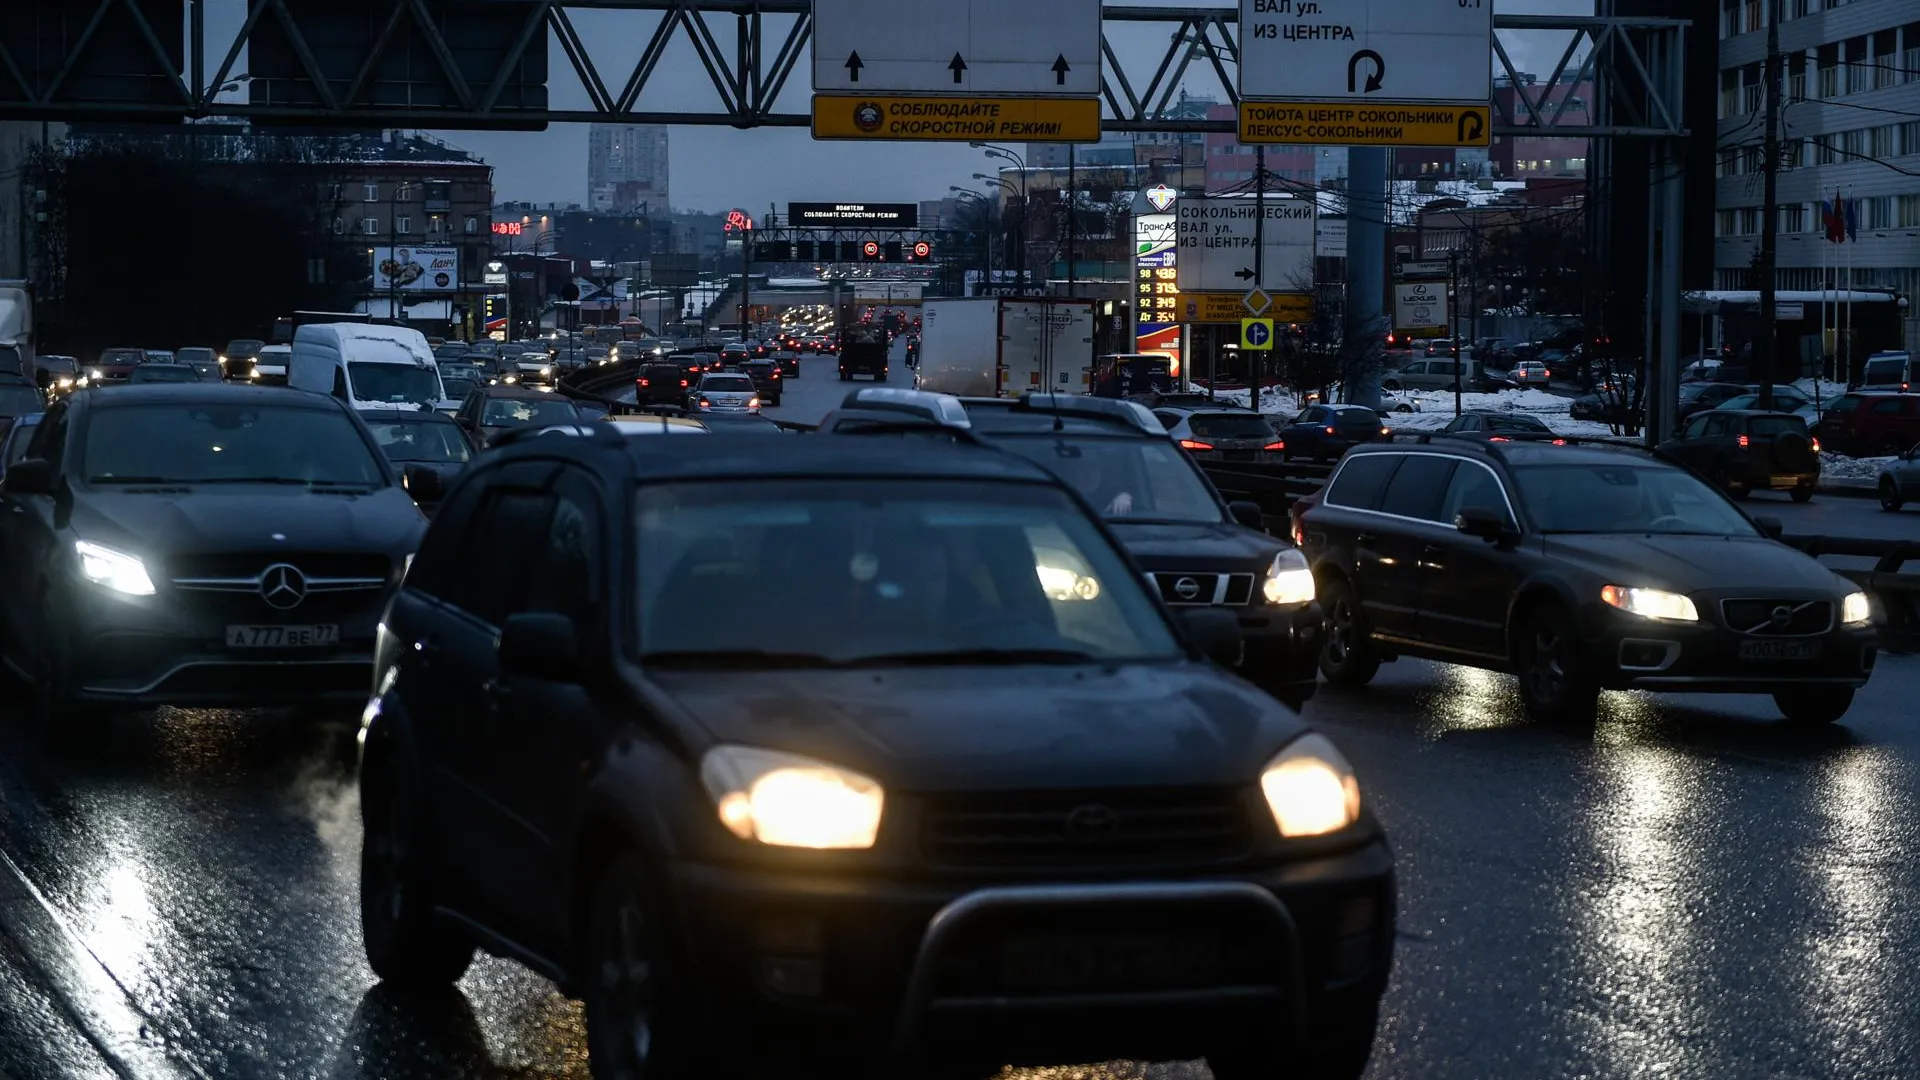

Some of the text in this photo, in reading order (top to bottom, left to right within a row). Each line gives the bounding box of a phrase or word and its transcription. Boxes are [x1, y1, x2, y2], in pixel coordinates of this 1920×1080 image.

[1297, 2, 1322, 17] ул.
[1254, 24, 1354, 41] ИЗ ЦЕНТРА
[890, 102, 1000, 117] СОБЛЮДАЙТЕ
[1247, 108, 1453, 123] ТОЙОТА ЦЕНТР СОКОЛЬНИКИ
[890, 119, 1061, 135] СКОРОСТНОЙ РЕЖИМ!
[1247, 125, 1402, 139] ЛЕКСУС-СОКОЛЬНИКИ
[1139, 222, 1177, 233] ТрансАЗ
[1181, 222, 1233, 235] ВАЛ ул.
[1180, 237, 1257, 248] ИЗ ЦЕНТРА
[1163, 251, 1176, 267] ЕВР
[1139, 269, 1151, 278] 98
[1139, 283, 1151, 293] 95
[1139, 298, 1151, 307] 92
